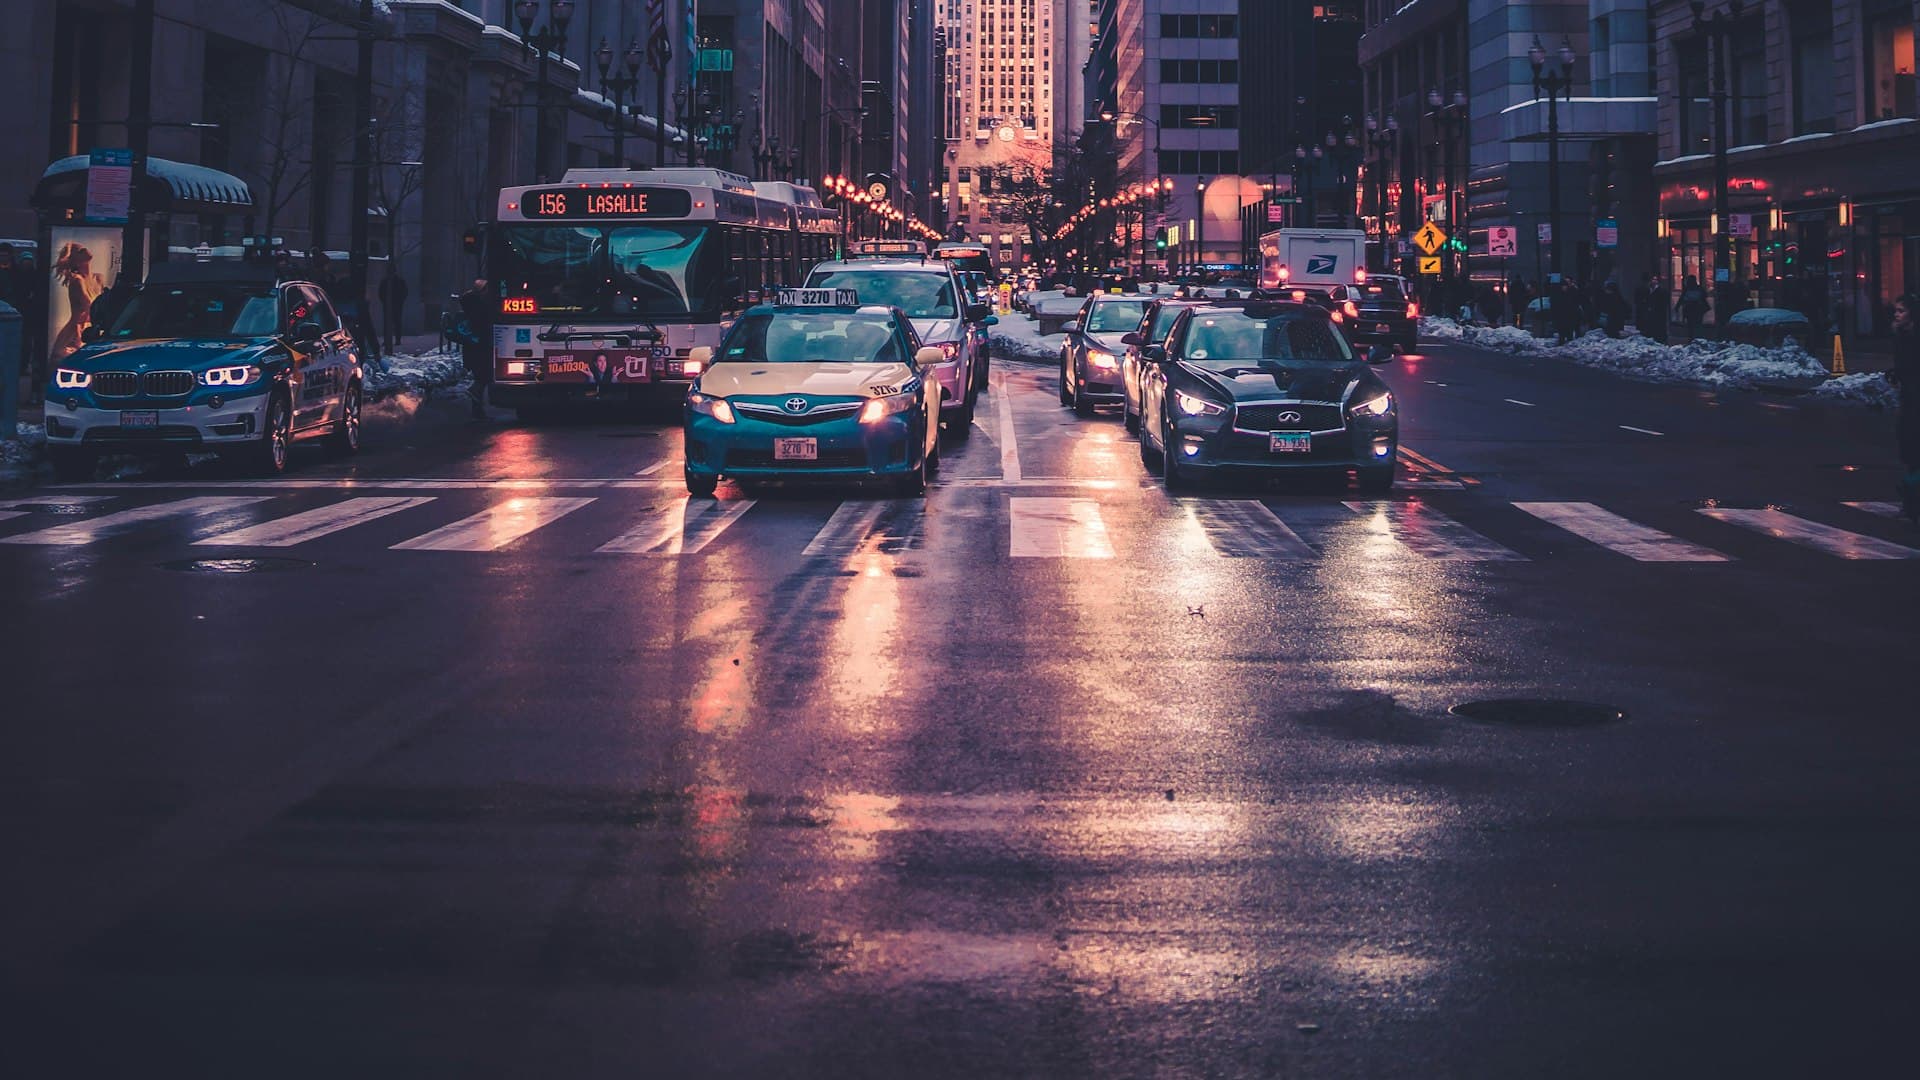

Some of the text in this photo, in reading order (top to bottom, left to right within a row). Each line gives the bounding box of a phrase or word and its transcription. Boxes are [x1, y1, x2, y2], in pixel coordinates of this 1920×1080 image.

[538, 194, 648, 214] 156 LASALLE
[779, 291, 855, 305] TAXI 3270 TAXI
[503, 299, 534, 312] K915
